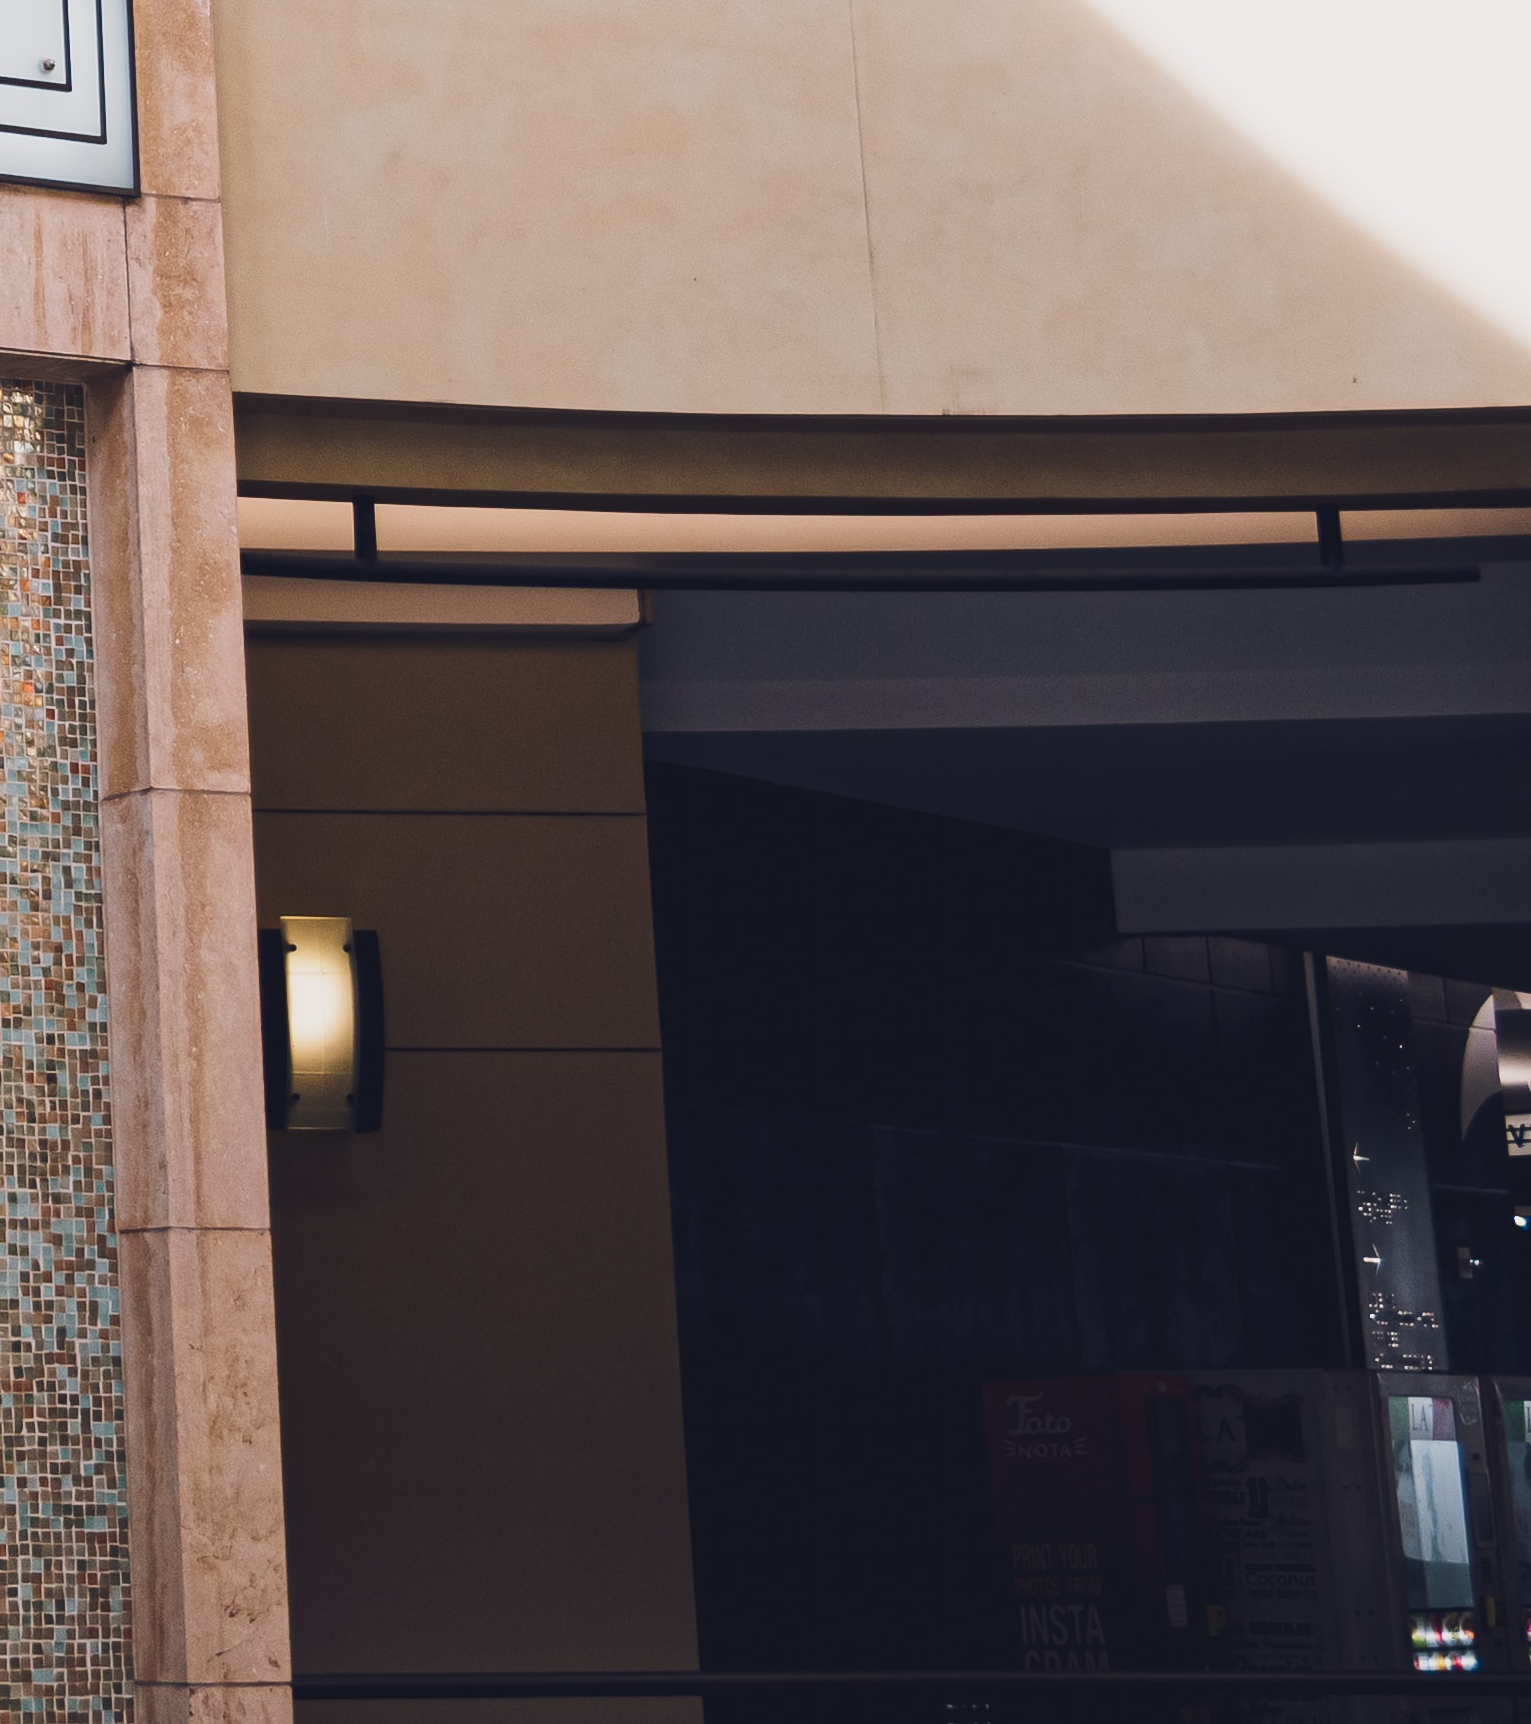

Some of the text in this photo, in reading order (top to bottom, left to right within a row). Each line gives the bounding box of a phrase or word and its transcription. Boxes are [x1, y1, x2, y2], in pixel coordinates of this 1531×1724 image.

[1005, 1391, 1073, 1436] Foto
[1017, 1442, 1074, 1460] NOTA
[1011, 1542, 1099, 1571] PRINT YOUR
[1246, 1571, 1315, 1587] Coconut
[1019, 1603, 1107, 1646] INSTA
